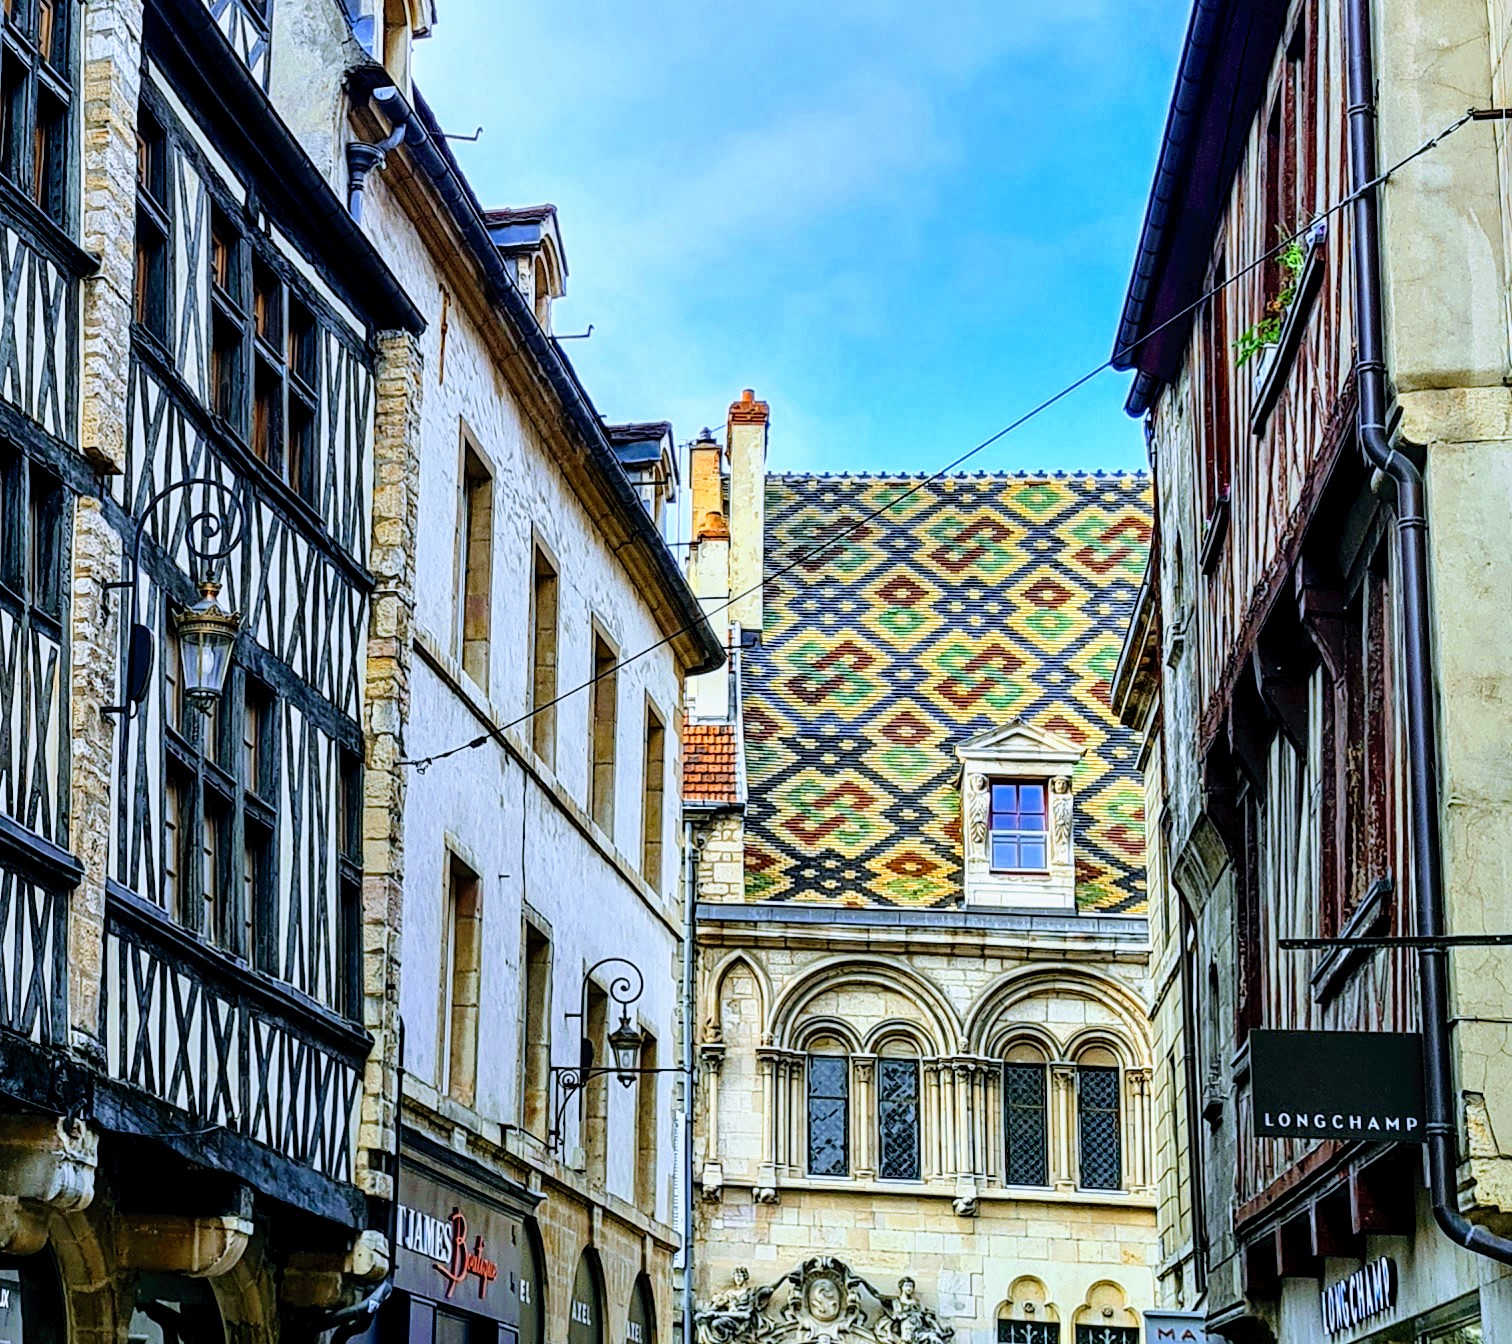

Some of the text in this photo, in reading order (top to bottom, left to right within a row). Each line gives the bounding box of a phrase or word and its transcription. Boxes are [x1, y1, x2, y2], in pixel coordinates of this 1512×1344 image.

[1264, 1112, 1419, 1132] LONGCHAMP
[405, 1208, 453, 1264] JAMES
[519, 1279, 531, 1305] EL
[1321, 1255, 1391, 1336] LONGCHAMP
[571, 1299, 592, 1326] AXEL
